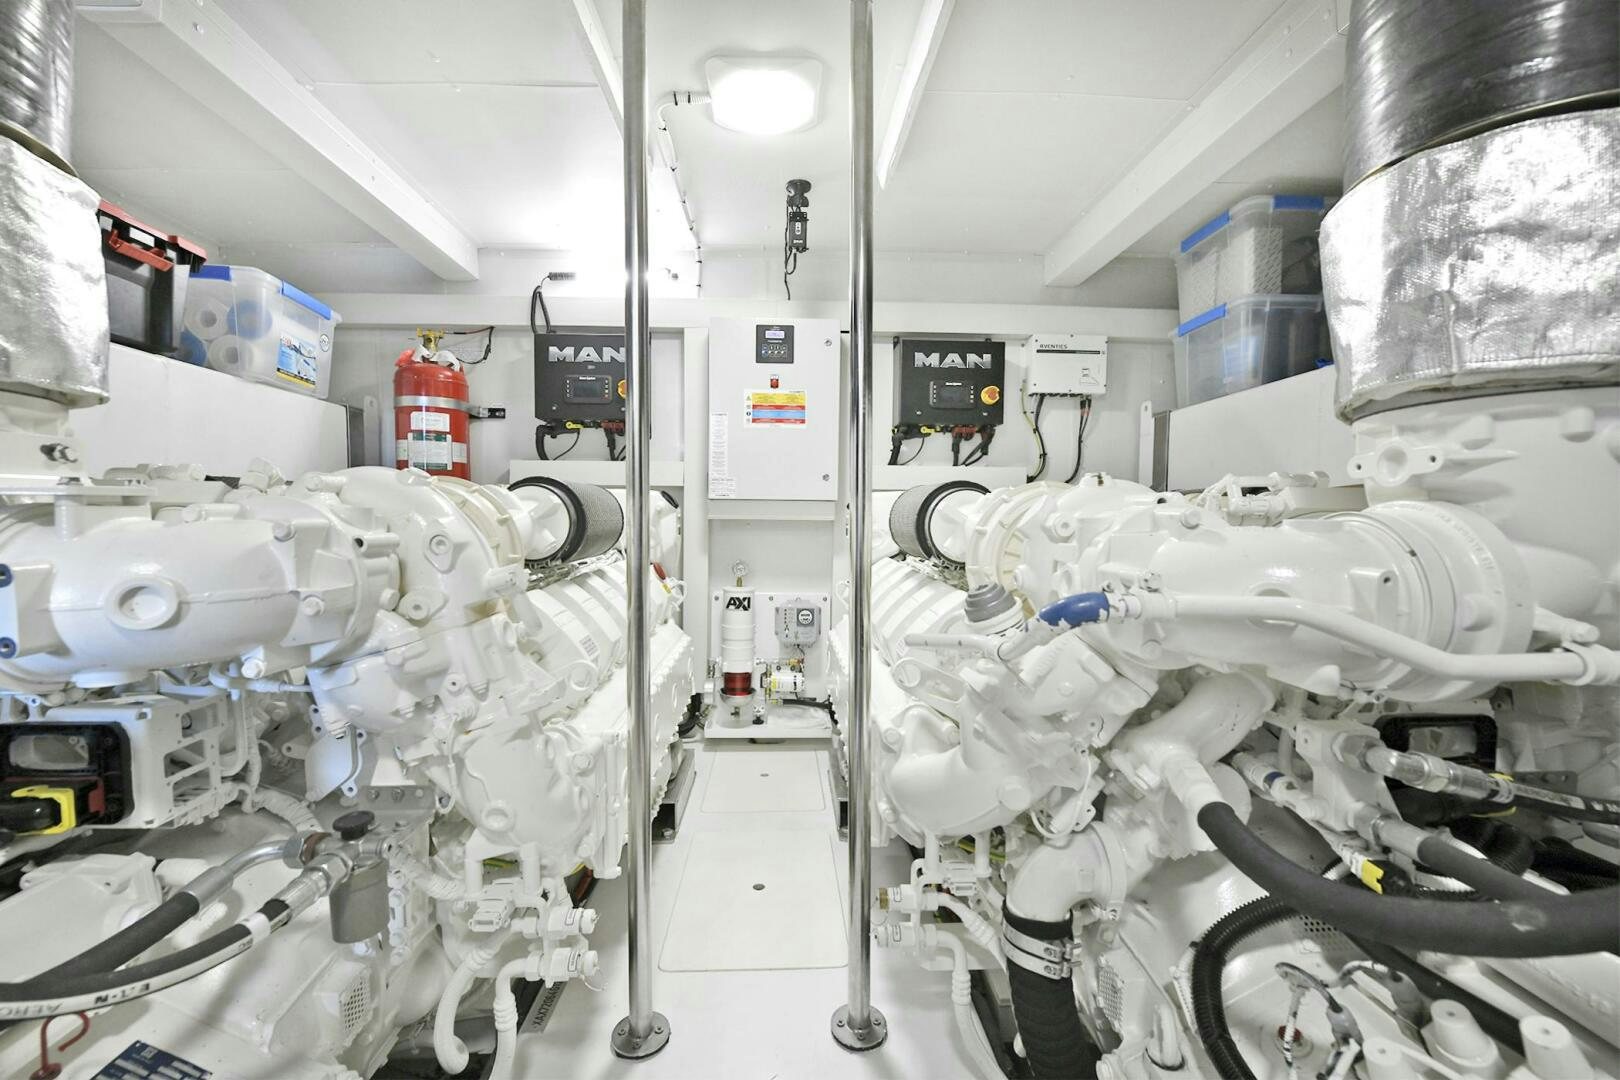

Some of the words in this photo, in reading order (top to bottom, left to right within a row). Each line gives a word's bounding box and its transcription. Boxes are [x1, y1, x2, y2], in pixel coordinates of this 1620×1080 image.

[548, 346, 626, 363] MAN
[914, 352, 991, 369] MAN
[726, 597, 751, 611] AXI
